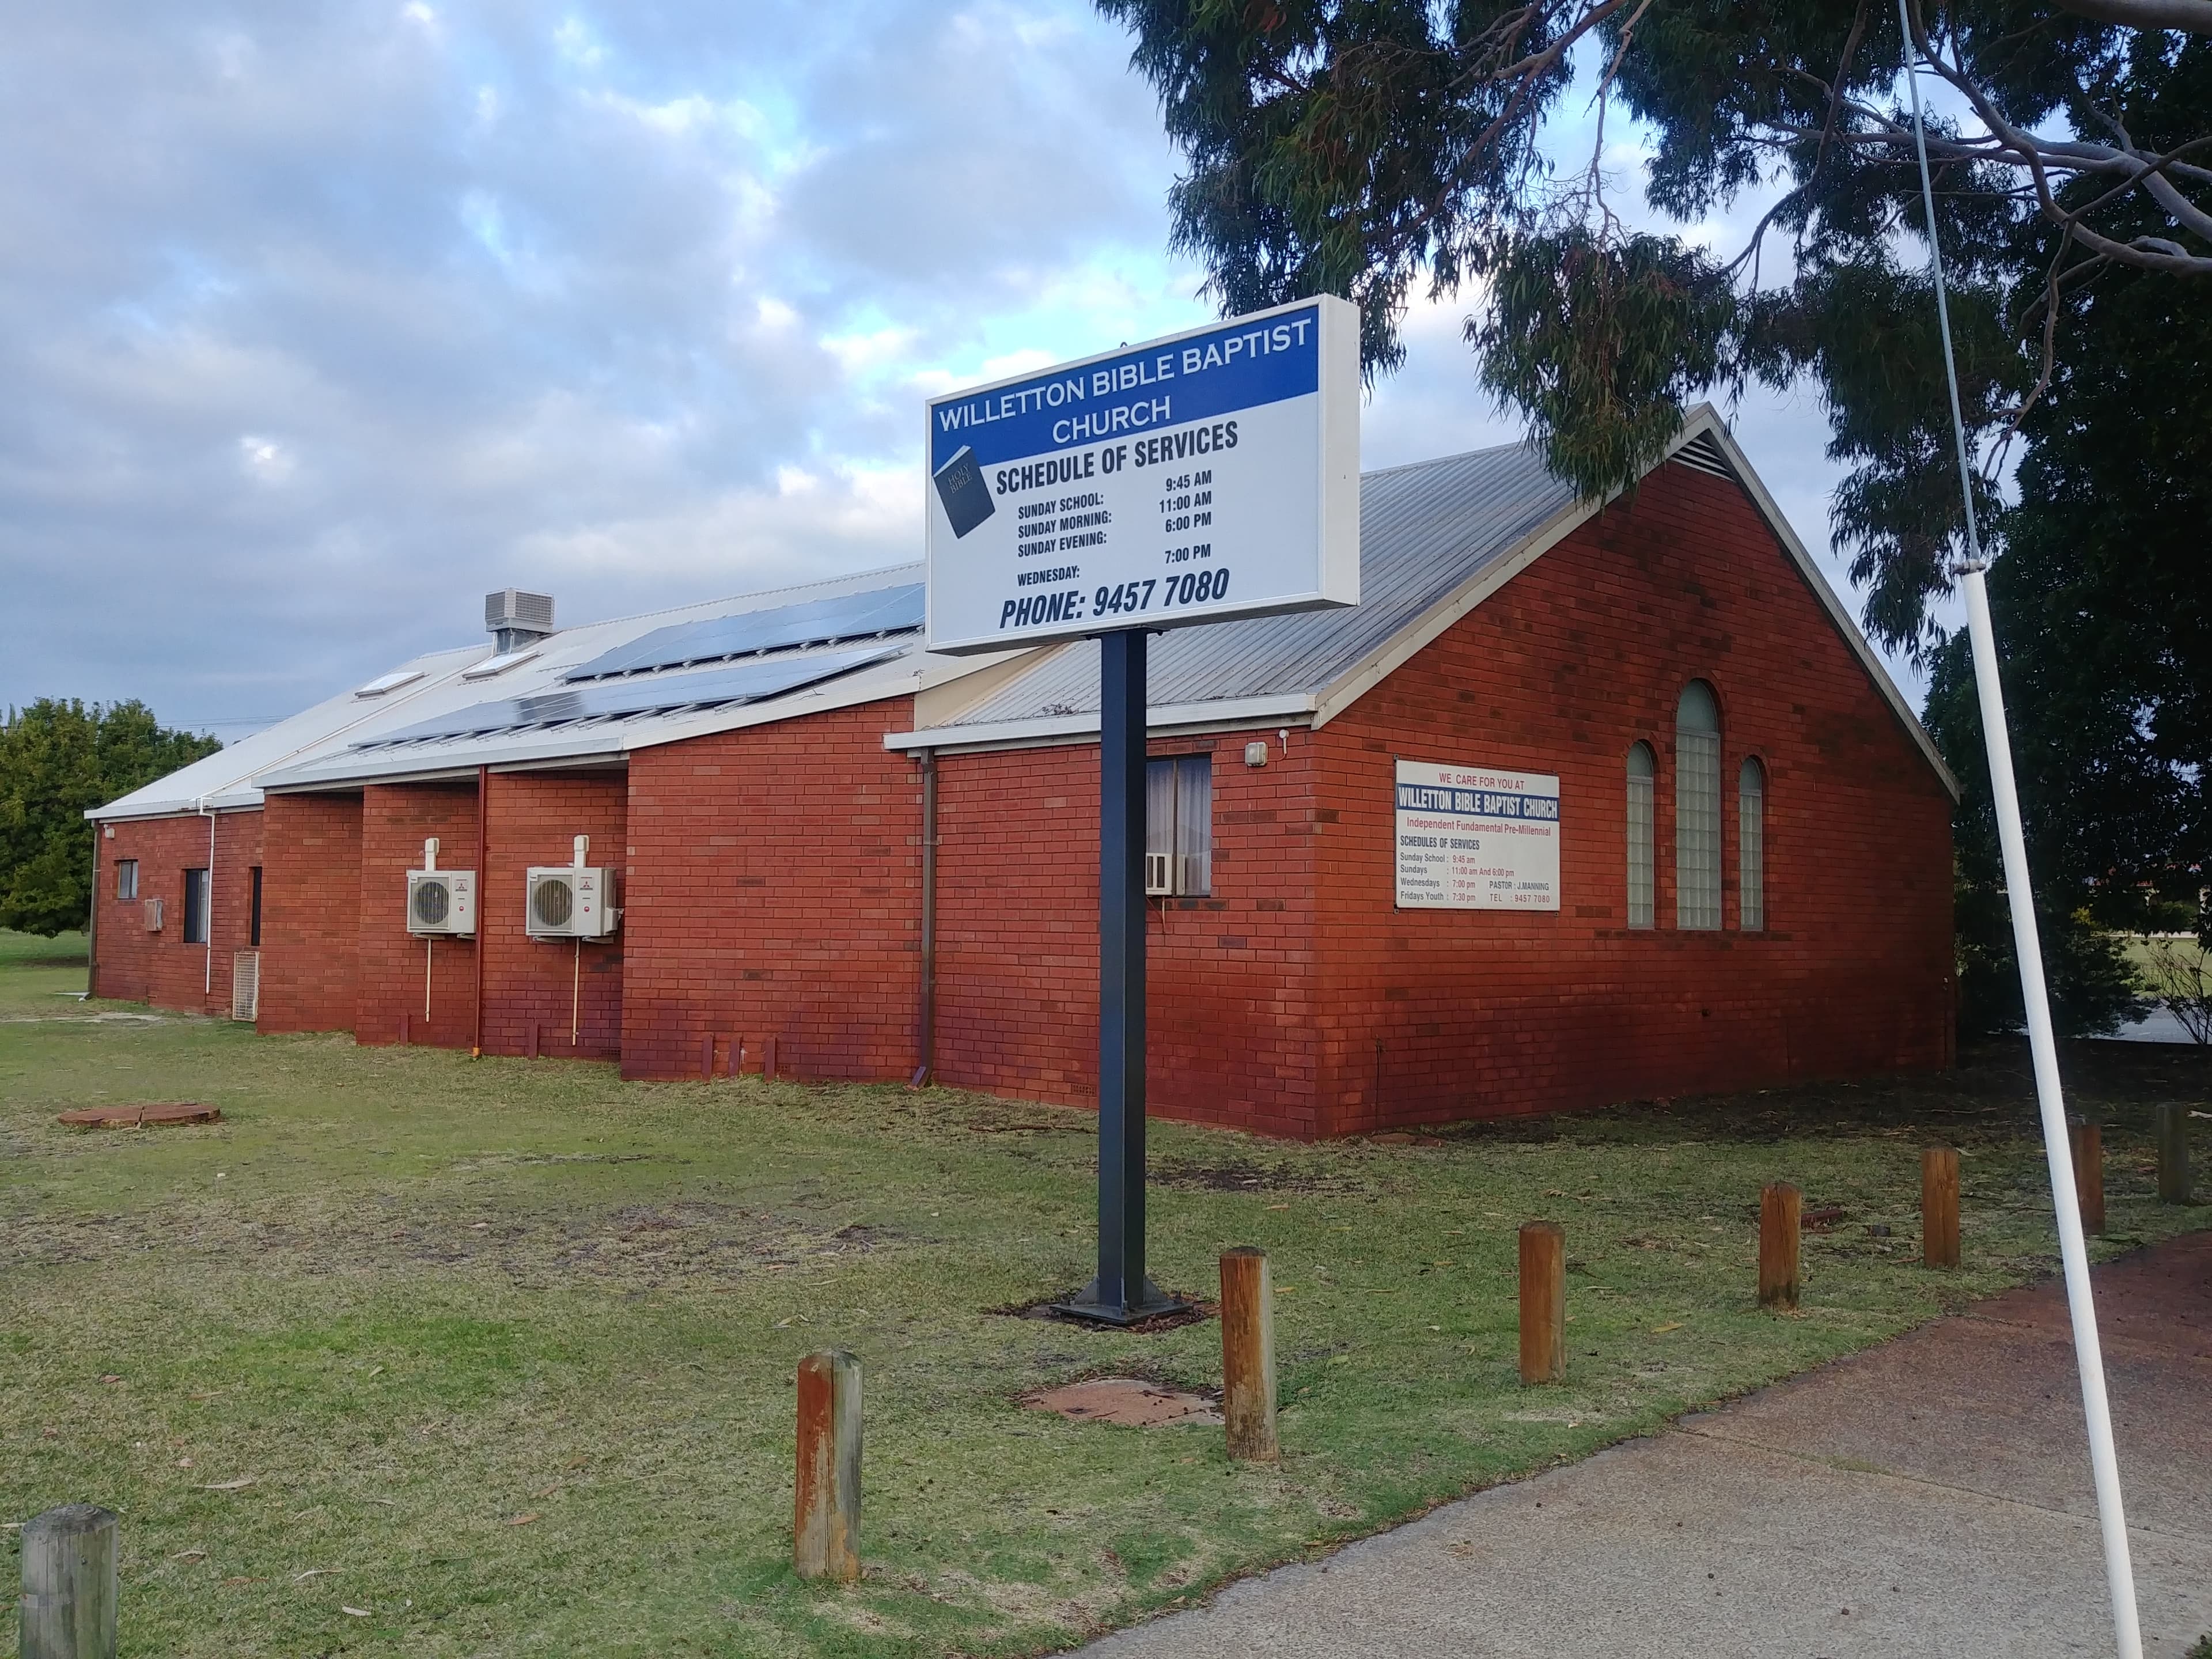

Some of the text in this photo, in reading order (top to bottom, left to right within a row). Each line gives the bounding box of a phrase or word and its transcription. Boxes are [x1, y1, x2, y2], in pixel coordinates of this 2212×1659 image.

[939, 317, 1311, 432] WILLETTON BIBLE BAPTIST
[1052, 395, 1171, 444] CHURCH
[997, 421, 1238, 495] SCHEDULE OF SERVICES
[947, 463, 969, 486] HOLY
[950, 474, 972, 494] BIBLE
[1018, 469, 1211, 520] SUNDAY SCHOOL: 9:45 AM
[1018, 491, 1211, 539] SUNDAY MORNING: 11:00 AM
[1018, 512, 1211, 558] SUNDAY EVENING: 6:00 PM
[1017, 543, 1211, 586] WEDNESDAY: 7:00 PM
[999, 568, 1230, 628] PHONE: 9457 7080
[1439, 772, 1525, 790] WE CARE FOR YOU AT
[1398, 787, 1558, 819] WILLETTON BIBLE BAPTIST CHURCH
[1407, 817, 1551, 836] Independent Fundamental Pre-Millennial
[1400, 835, 1480, 850] SCHEDULES OF SERVICES
[1400, 852, 1423, 863] Sunday
[1453, 855, 1465, 863] 9:45
[1400, 864, 1427, 876] Sundays
[1479, 868, 1491, 876] And
[1493, 868, 1504, 876] 6:00
[1505, 870, 1514, 878] pm
[1401, 877, 1440, 889] Wednesdays
[1452, 880, 1465, 888] 7:00
[1489, 881, 1512, 889] PASTOR
[1400, 891, 1424, 902] Fridays
[1426, 892, 1444, 900] Youth
[1453, 893, 1465, 901] 7:30
[1467, 895, 1476, 903] pm
[1490, 894, 1502, 902] TEL
[1514, 895, 1531, 903] 9457
[1534, 895, 1550, 903] 7080
